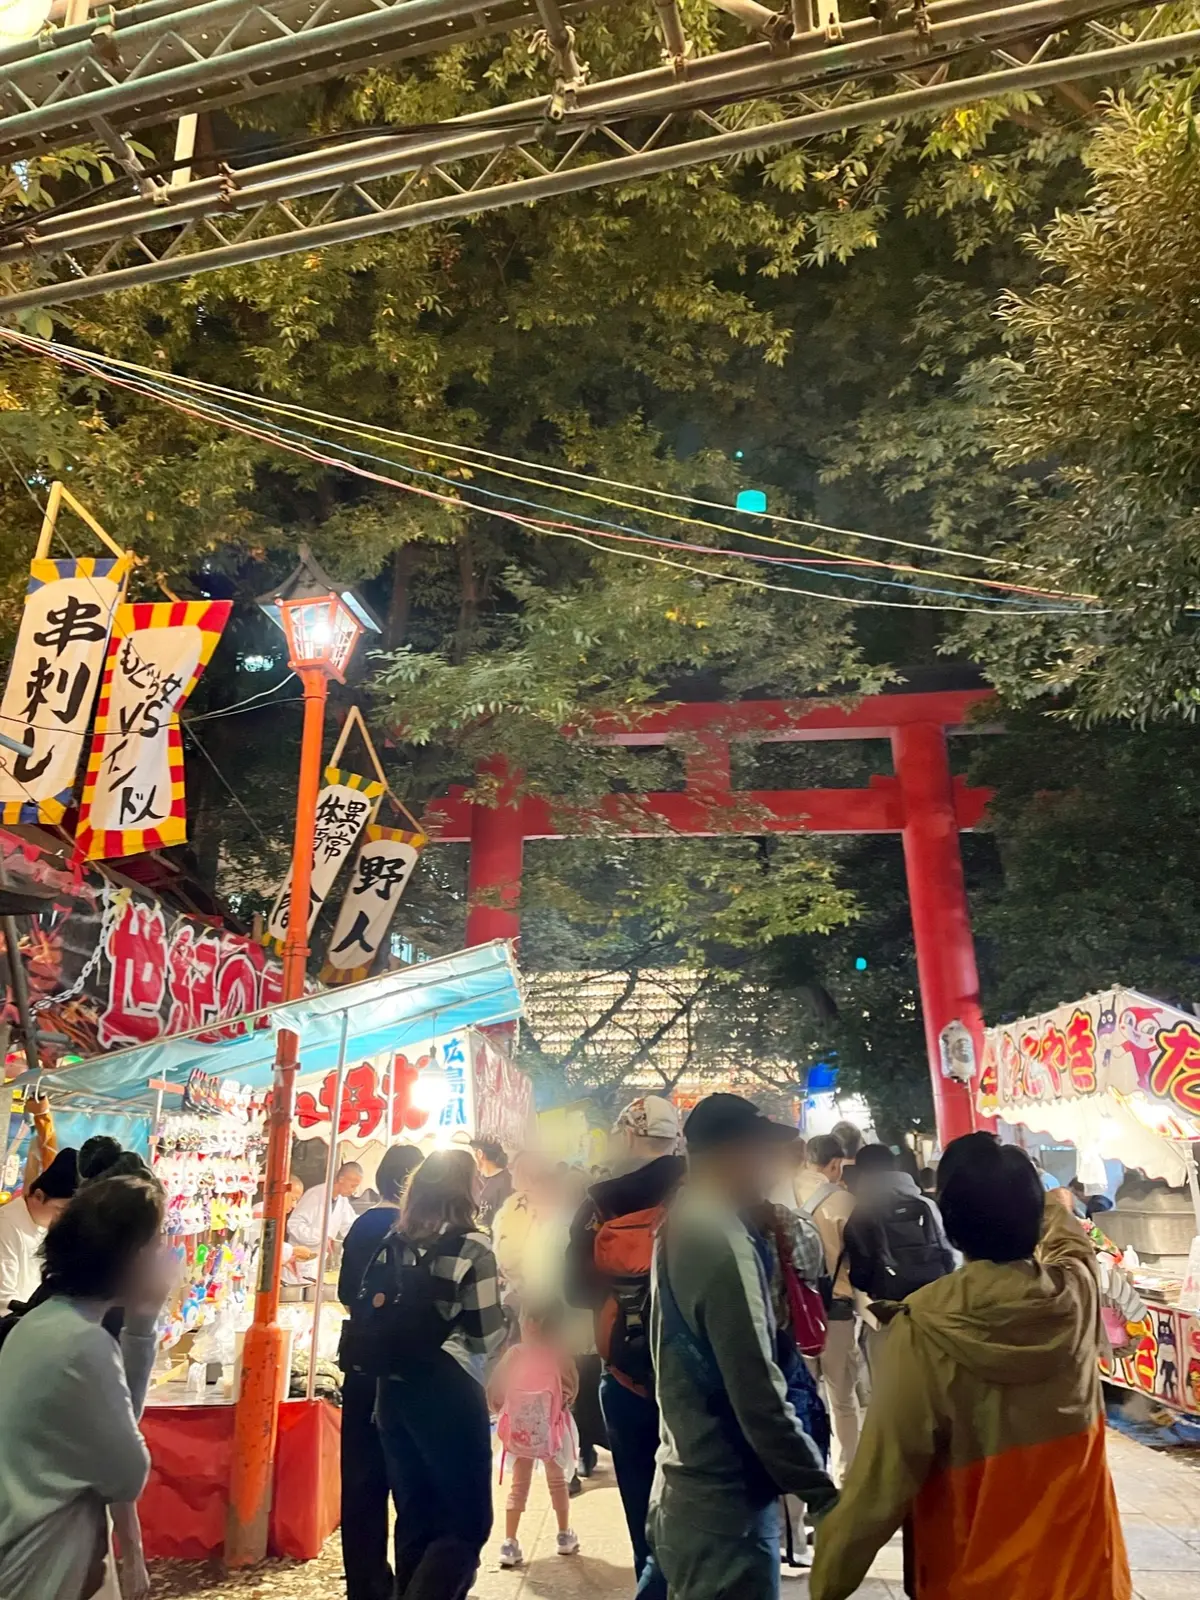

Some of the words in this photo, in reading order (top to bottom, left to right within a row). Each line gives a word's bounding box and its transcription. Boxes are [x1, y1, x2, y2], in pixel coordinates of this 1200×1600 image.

[14, 596, 107, 783] 串刺し
[120, 700, 164, 738] VS
[101, 738, 166, 826] インド人
[324, 800, 367, 865] 異常
[332, 856, 406, 953] 野人
[439, 1037, 468, 1127] 広島風
